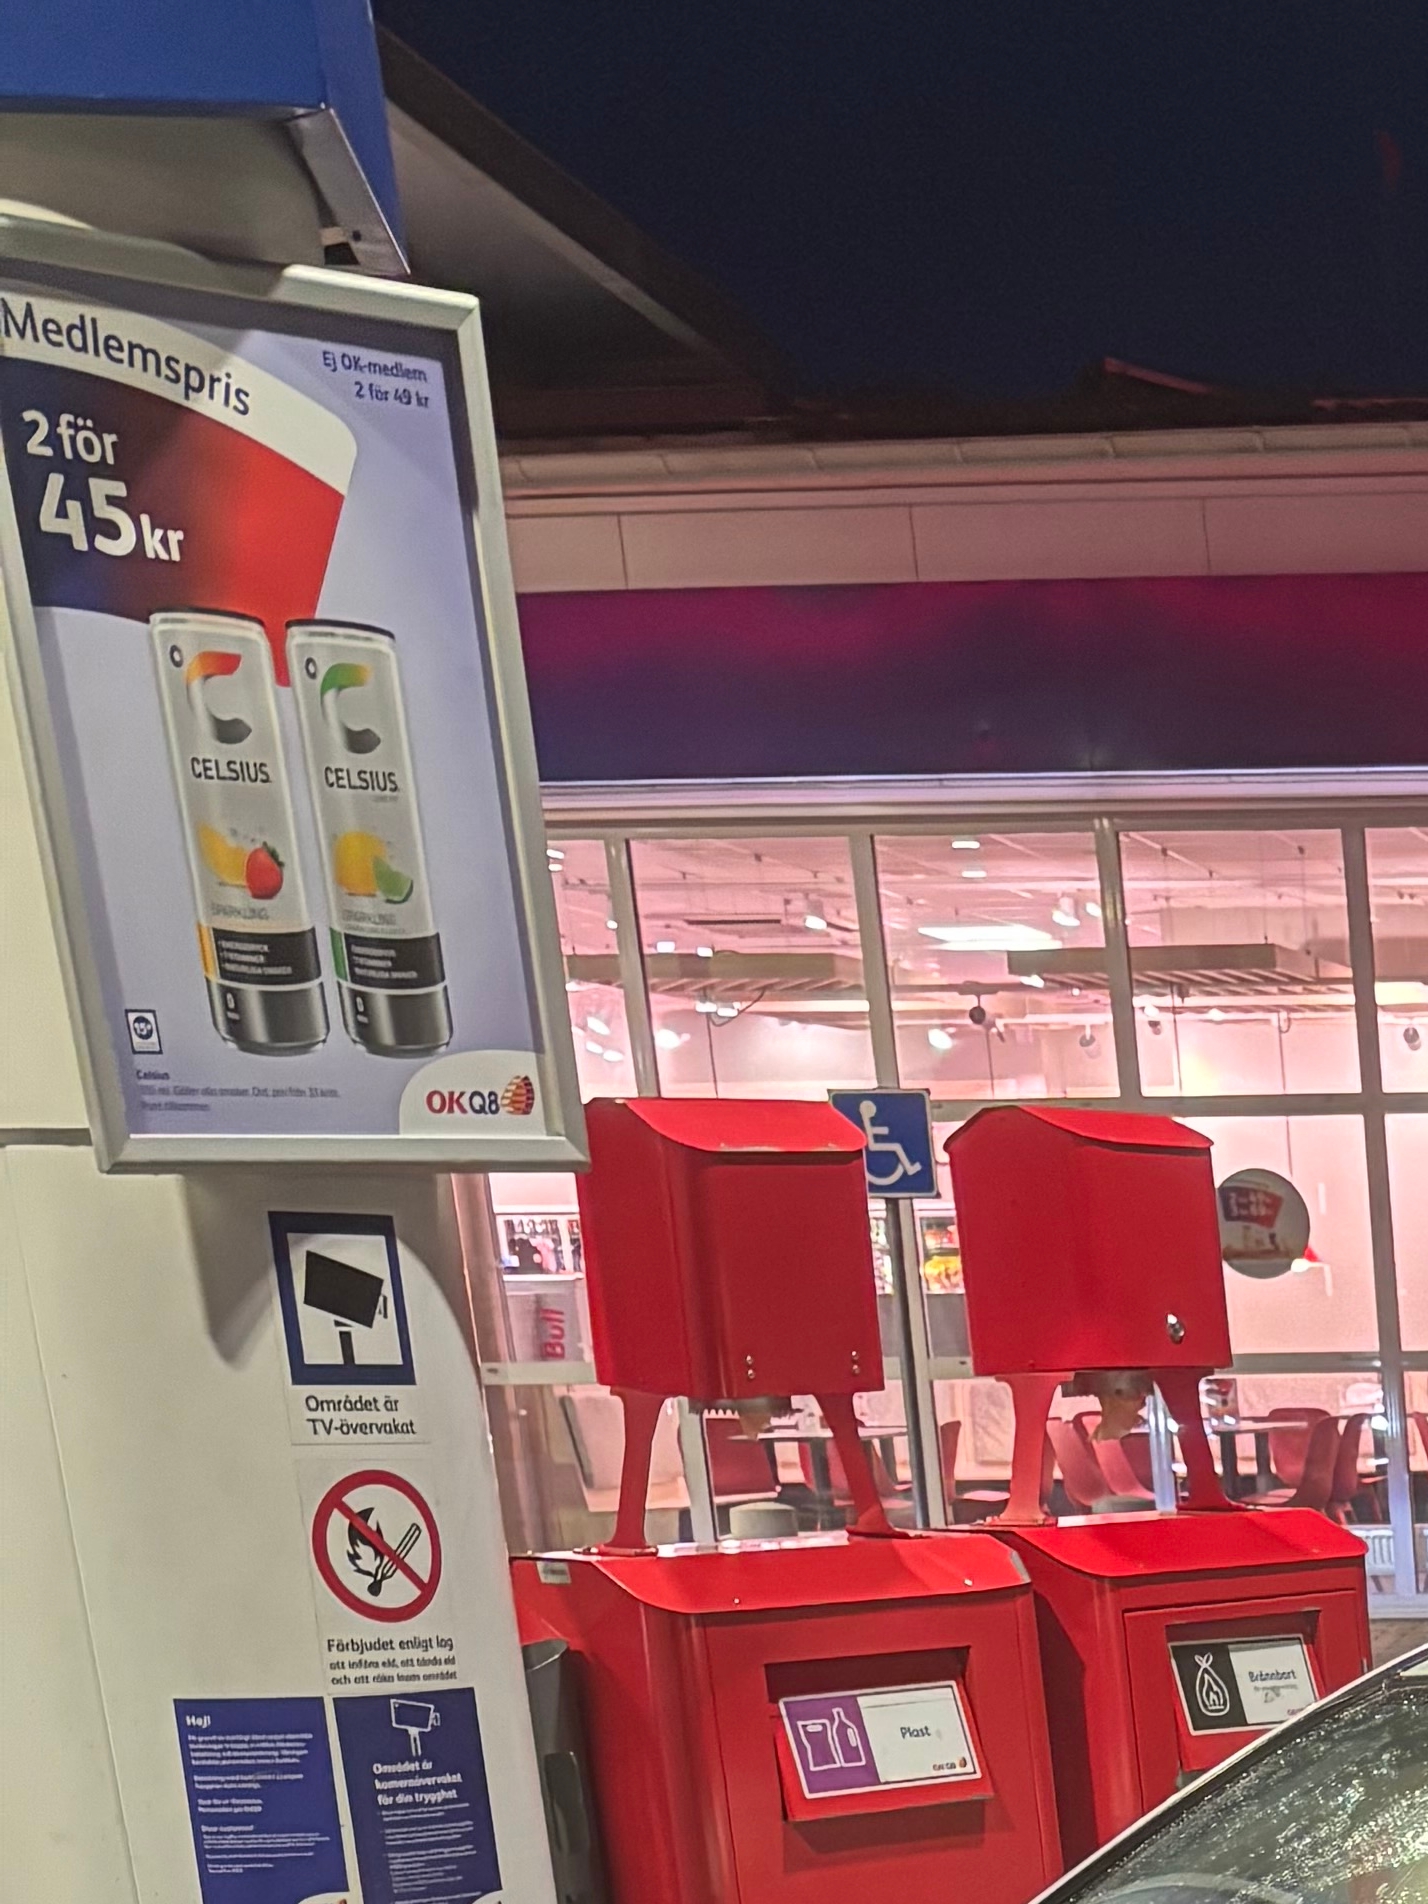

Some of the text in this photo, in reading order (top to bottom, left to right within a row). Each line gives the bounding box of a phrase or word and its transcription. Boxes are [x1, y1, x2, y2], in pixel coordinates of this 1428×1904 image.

[2, 299, 251, 417] Medlemspris
[322, 350, 428, 383] Ej OK-medlem
[354, 381, 429, 409] 2 för 49 kr
[22, 410, 119, 466] 2 för
[191, 756, 271, 784] CELSIUS
[324, 766, 399, 793] CELSIUS
[541, 1308, 566, 1359] Bull
[305, 1394, 399, 1412] Området är
[306, 1417, 417, 1436] TV-övervakat
[327, 1637, 395, 1655] Förbjudet
[399, 1637, 434, 1652] enligt
[329, 1659, 346, 1670] att
[331, 1674, 351, 1686] och
[186, 1715, 211, 1729] Hej!
[900, 1725, 931, 1739] Plast
